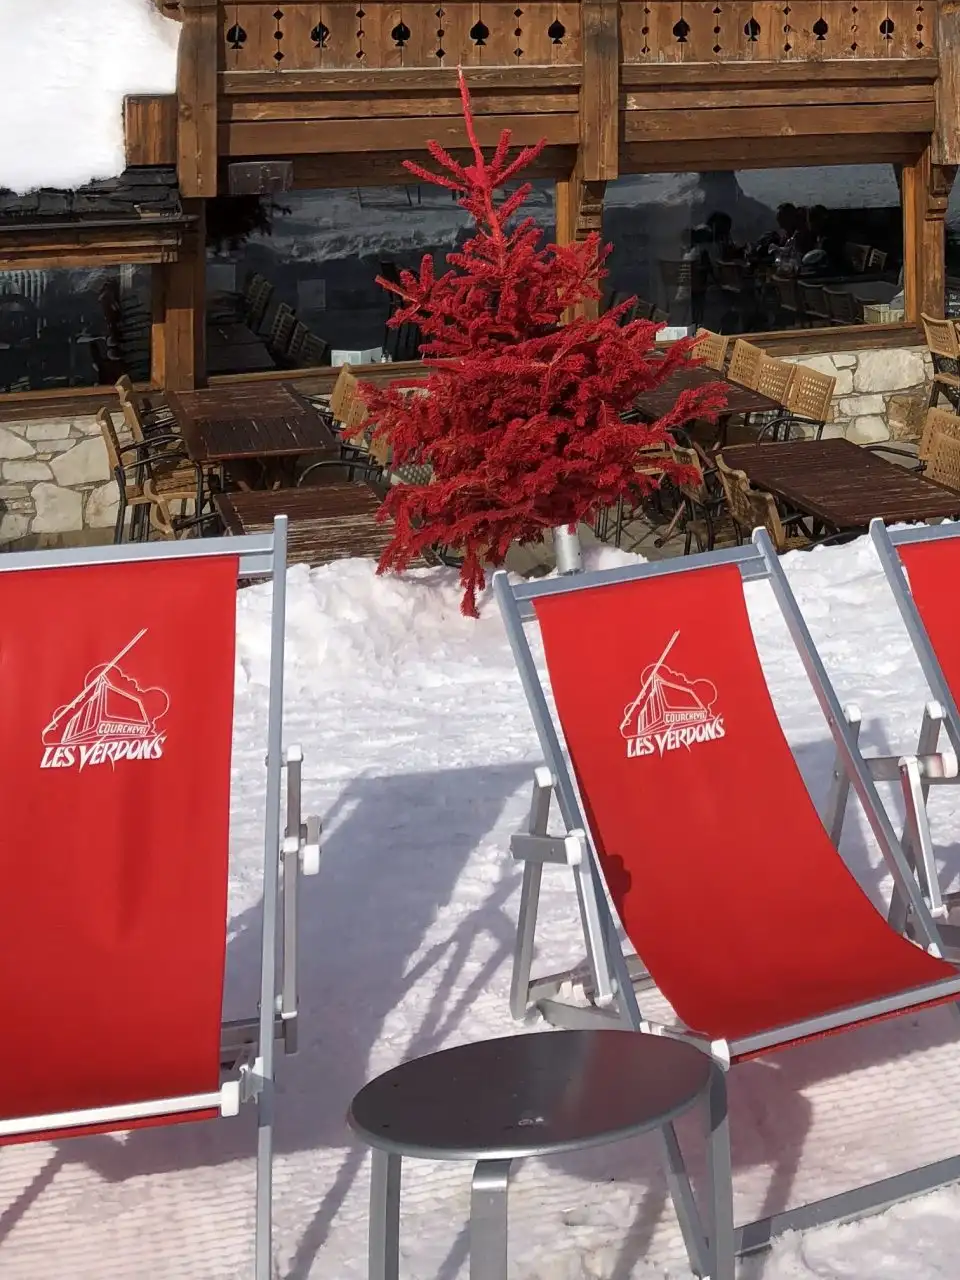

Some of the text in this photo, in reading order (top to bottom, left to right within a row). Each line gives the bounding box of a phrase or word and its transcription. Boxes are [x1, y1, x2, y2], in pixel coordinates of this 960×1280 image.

[40, 729, 167, 773] LES VERDONS
[98, 723, 147, 735] COURCHEVEL
[626, 713, 725, 759] LES VERDONS
